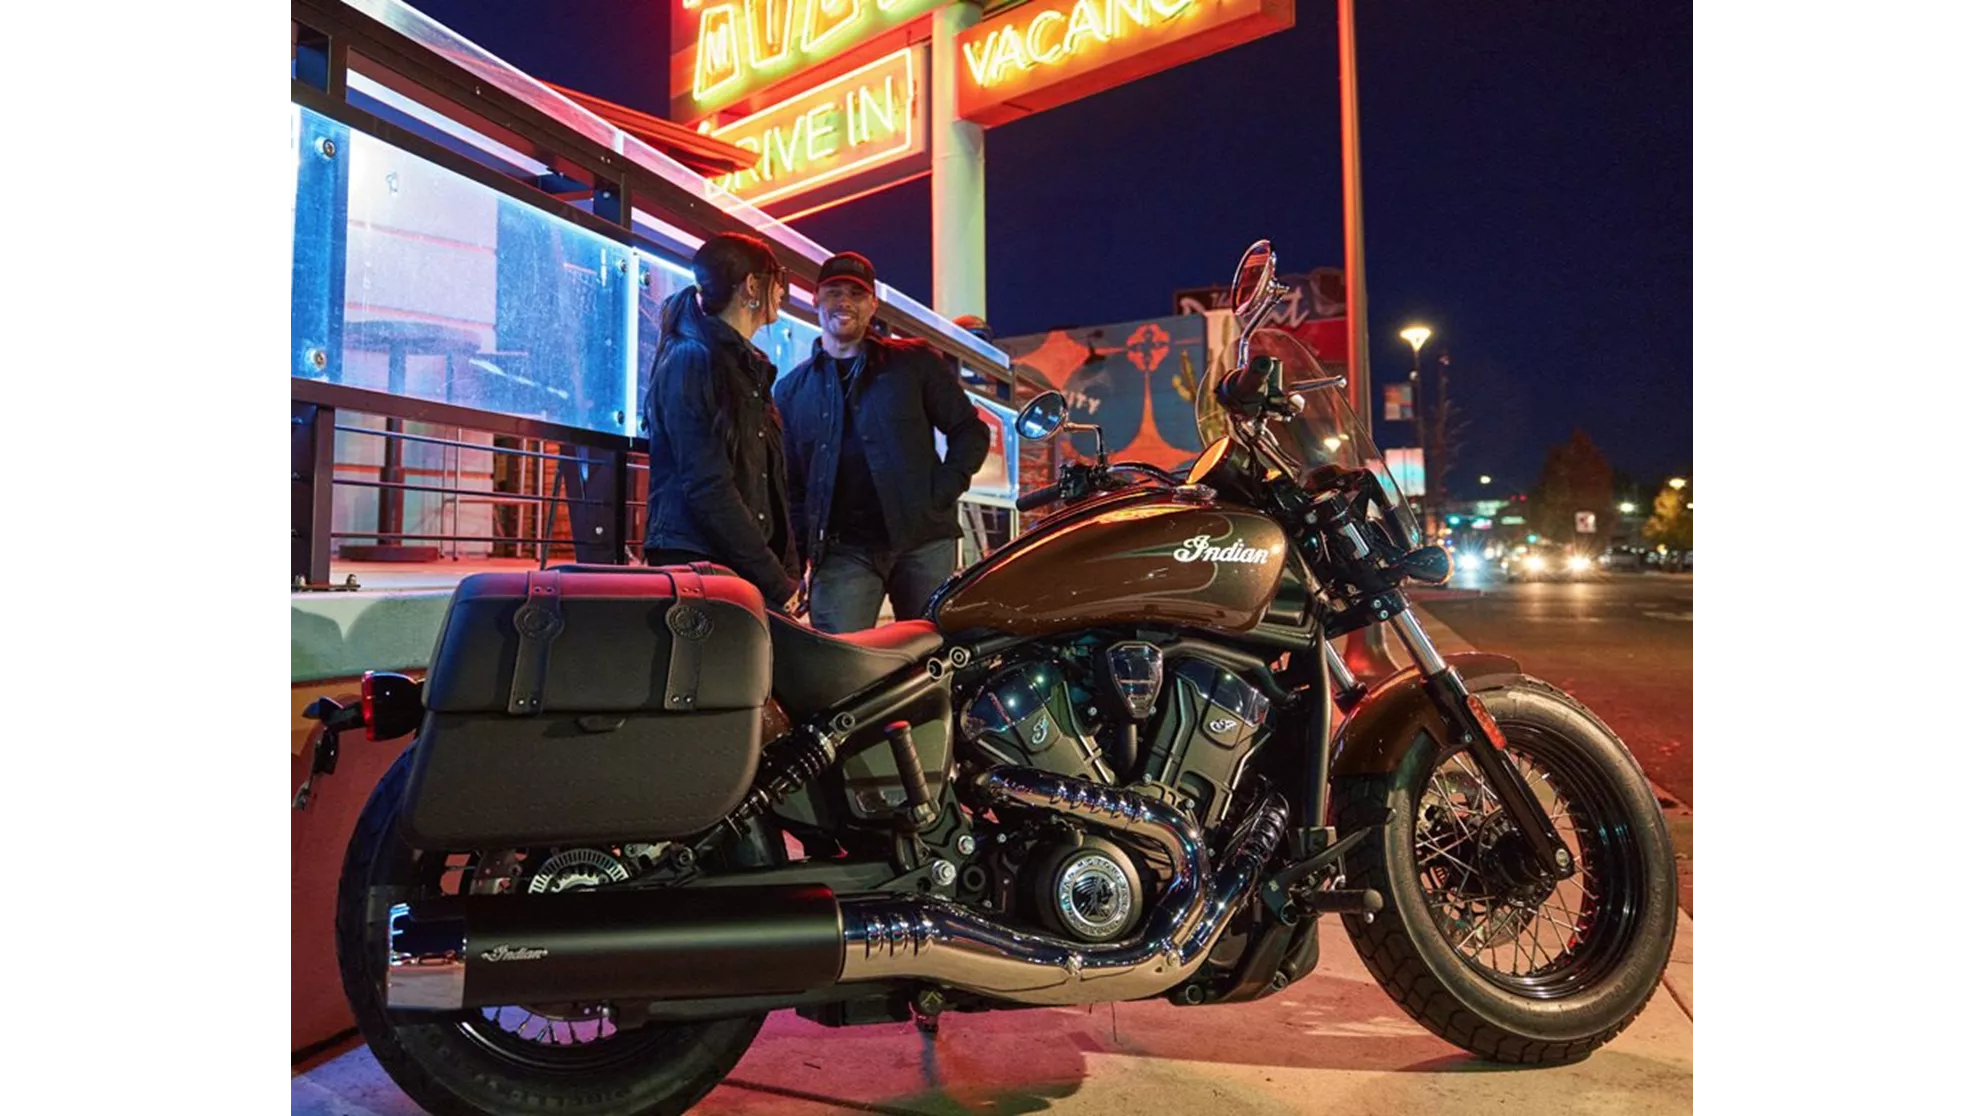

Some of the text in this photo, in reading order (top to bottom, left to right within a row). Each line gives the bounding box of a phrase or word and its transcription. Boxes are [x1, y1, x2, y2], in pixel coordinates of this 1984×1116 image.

[846, 75, 895, 147] IN
[1173, 534, 1269, 564] Indian
[481, 944, 548, 961] Indian
